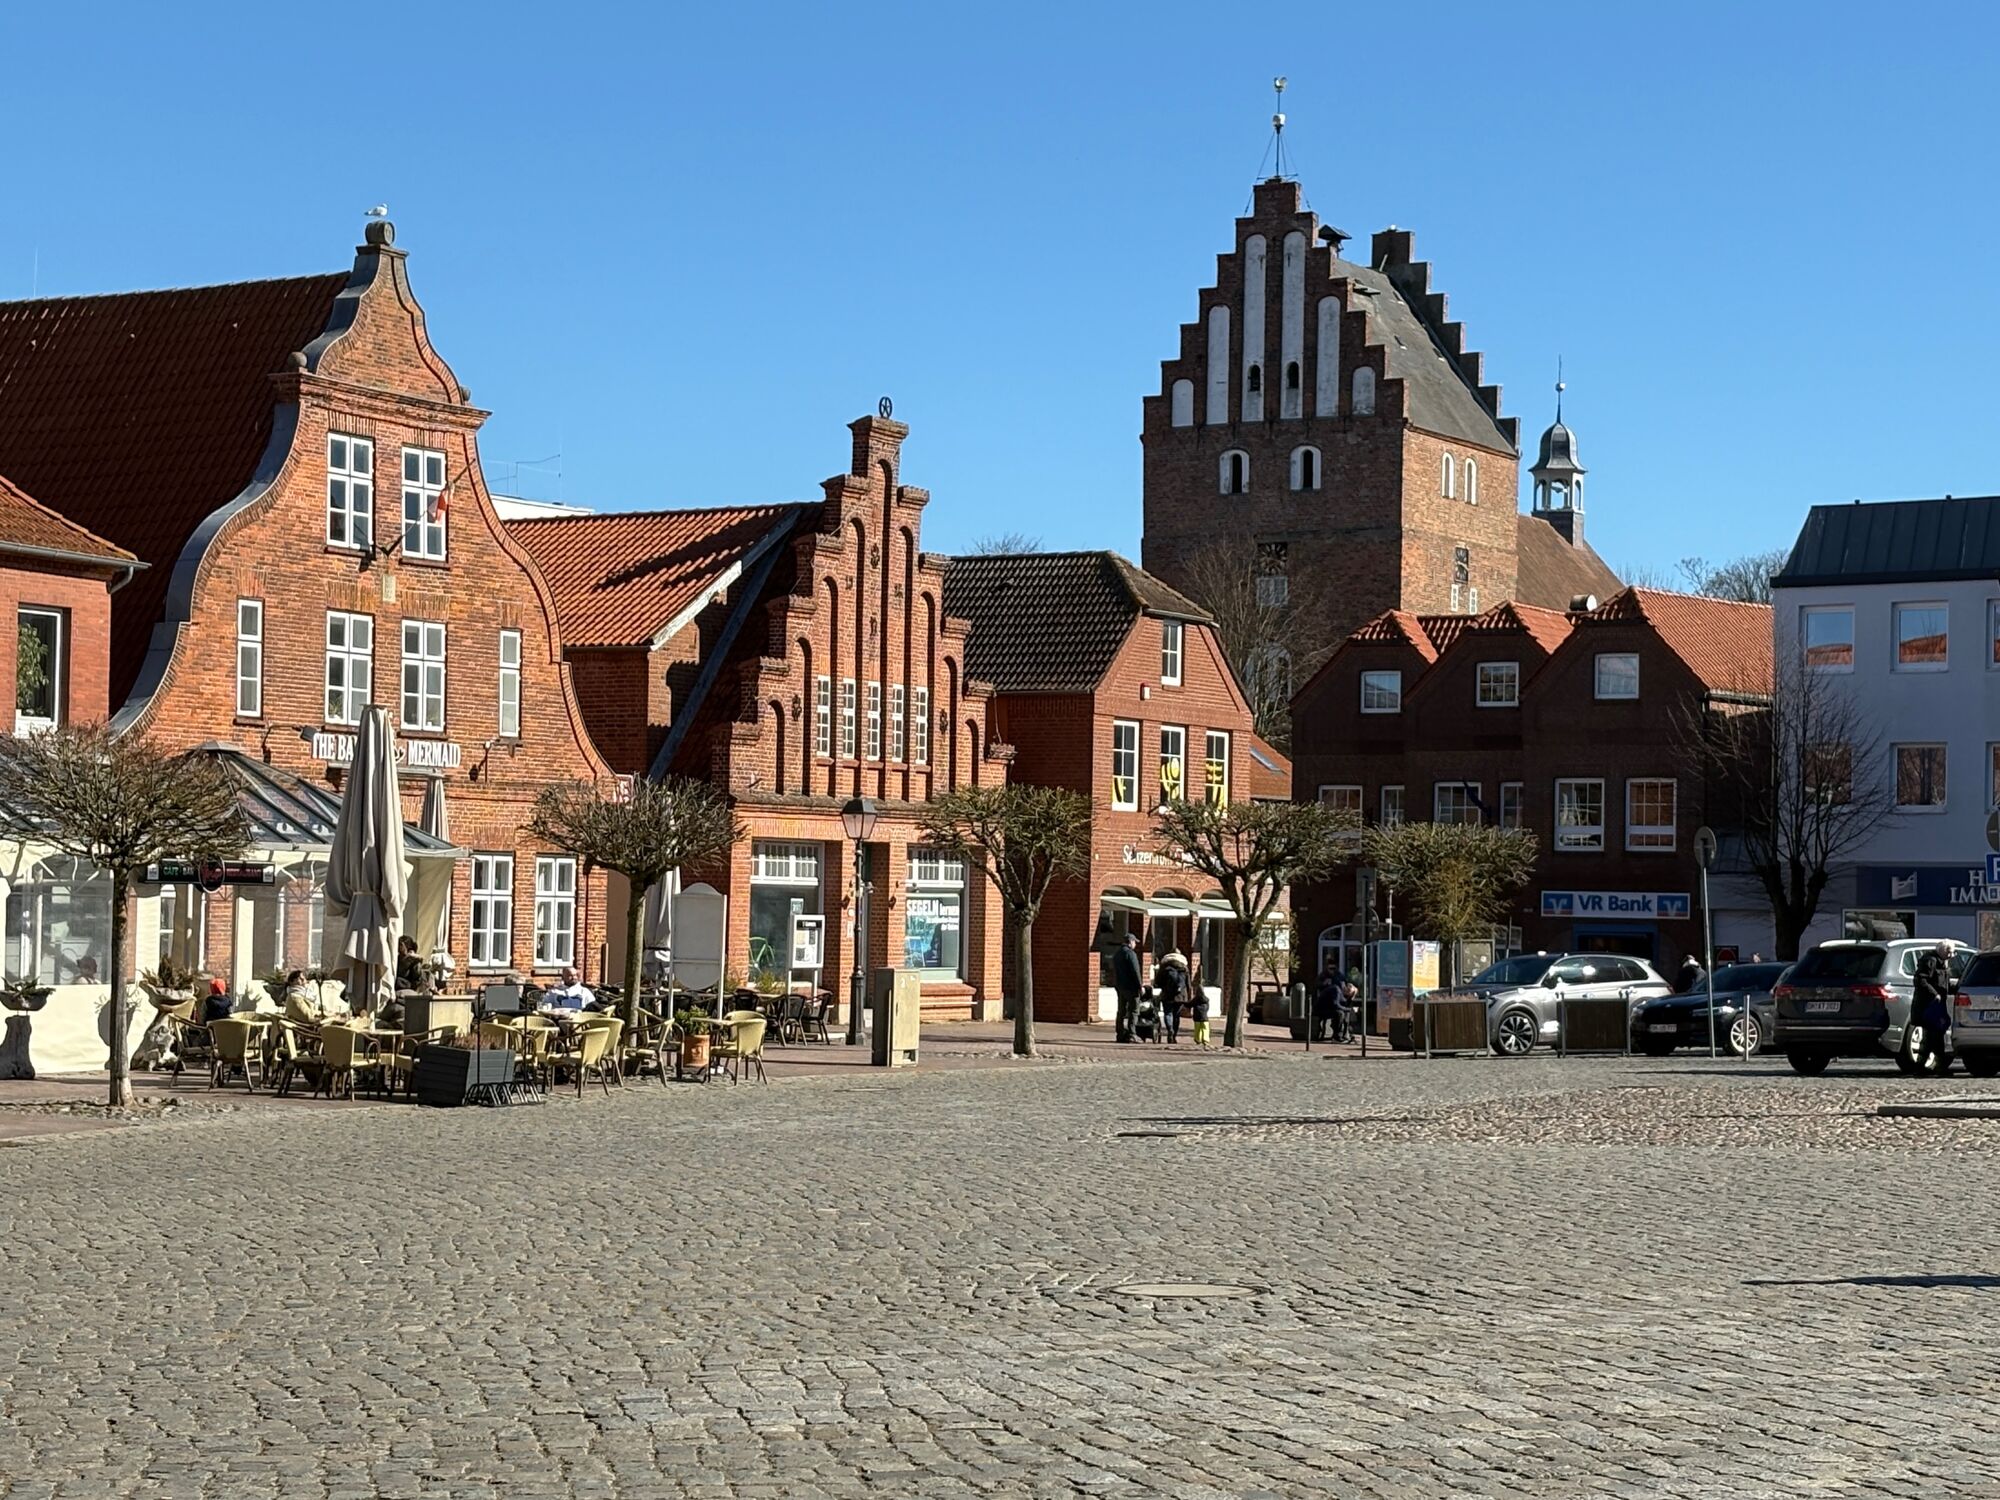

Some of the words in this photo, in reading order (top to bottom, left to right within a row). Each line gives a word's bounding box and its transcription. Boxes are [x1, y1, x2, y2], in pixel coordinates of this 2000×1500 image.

[312, 733, 335, 759] THE
[337, 735, 358, 761] BA
[407, 740, 460, 767] MERMAID
[906, 899, 939, 916] SEGELN
[1578, 895, 1603, 911] VR
[1608, 895, 1652, 912] Bank
